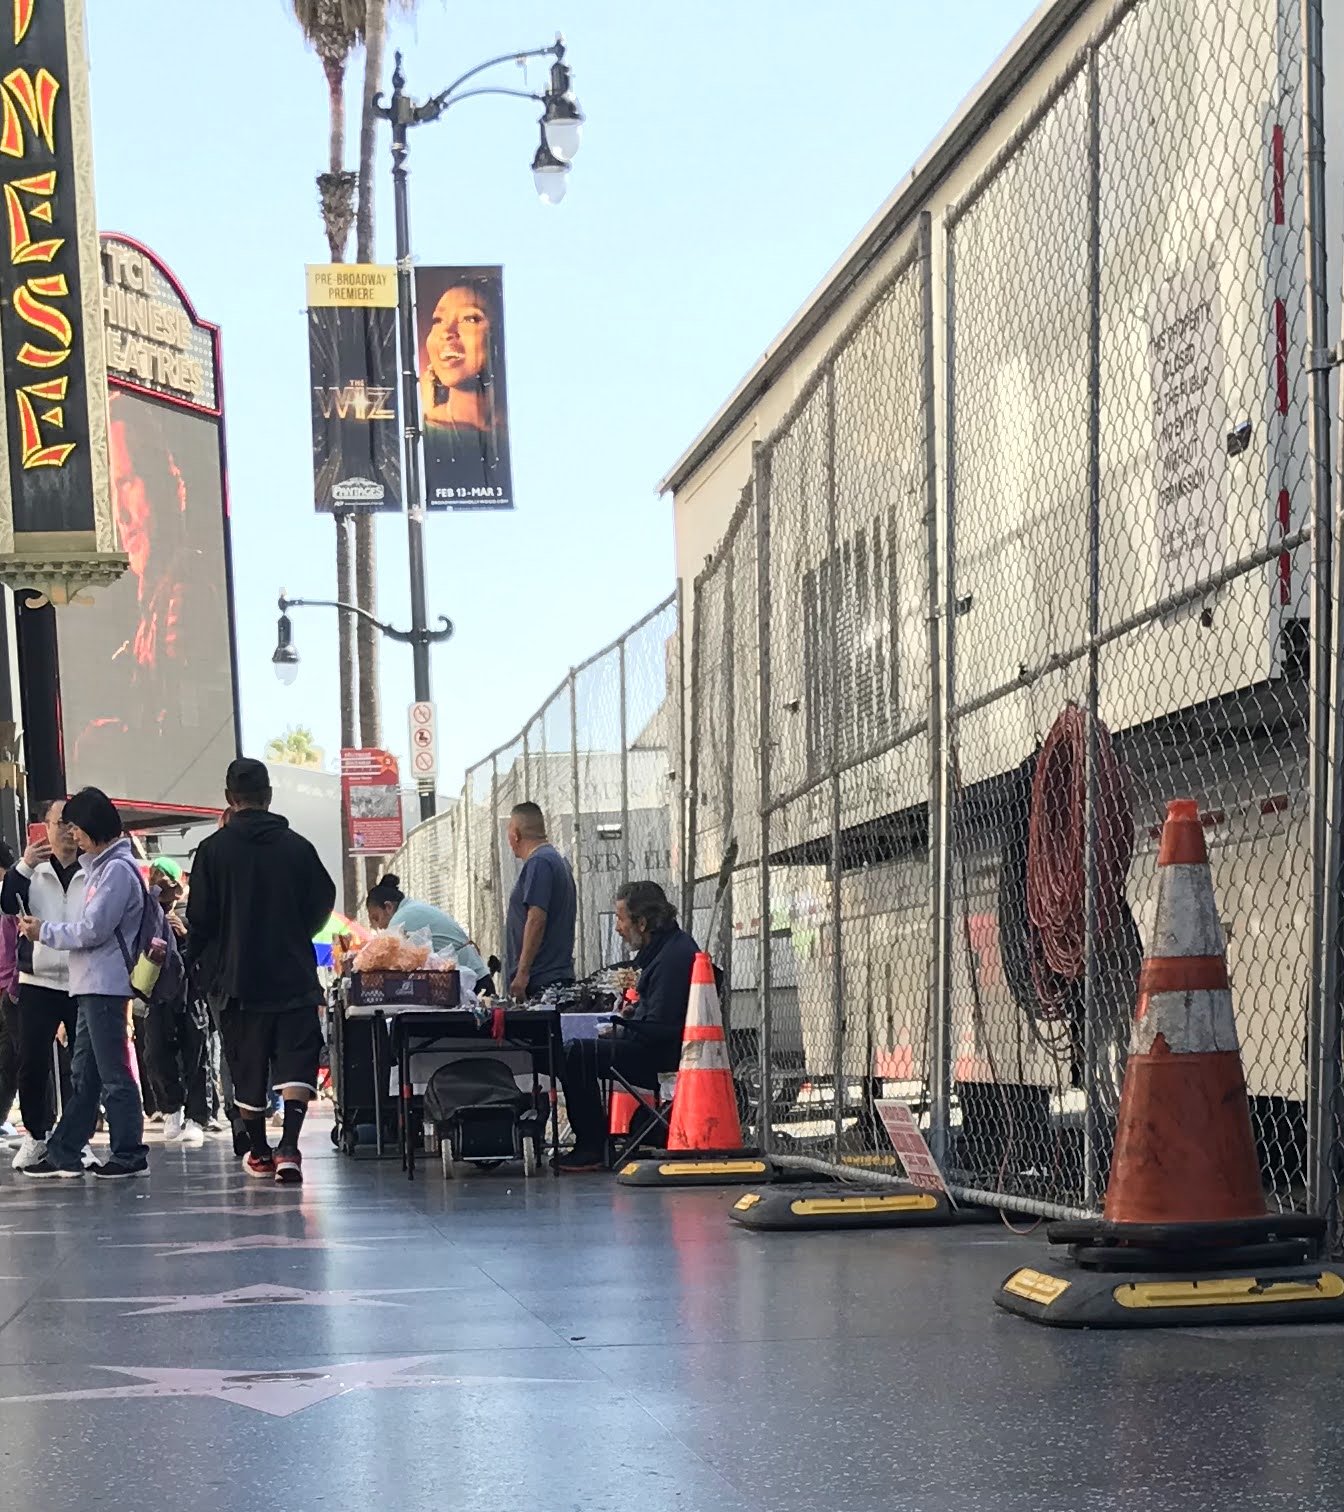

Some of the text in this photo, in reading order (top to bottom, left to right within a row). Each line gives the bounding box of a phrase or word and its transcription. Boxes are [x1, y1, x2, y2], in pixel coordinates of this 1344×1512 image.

[103, 242, 159, 296] TCL
[314, 272, 388, 286] PRE-BROADWAY
[328, 287, 376, 300] PREMIERE
[102, 285, 194, 351] HINESE
[106, 327, 204, 397] EATRES
[313, 386, 396, 420] WIZ
[435, 487, 454, 498] FEB
[497, 486, 503, 497] 3
